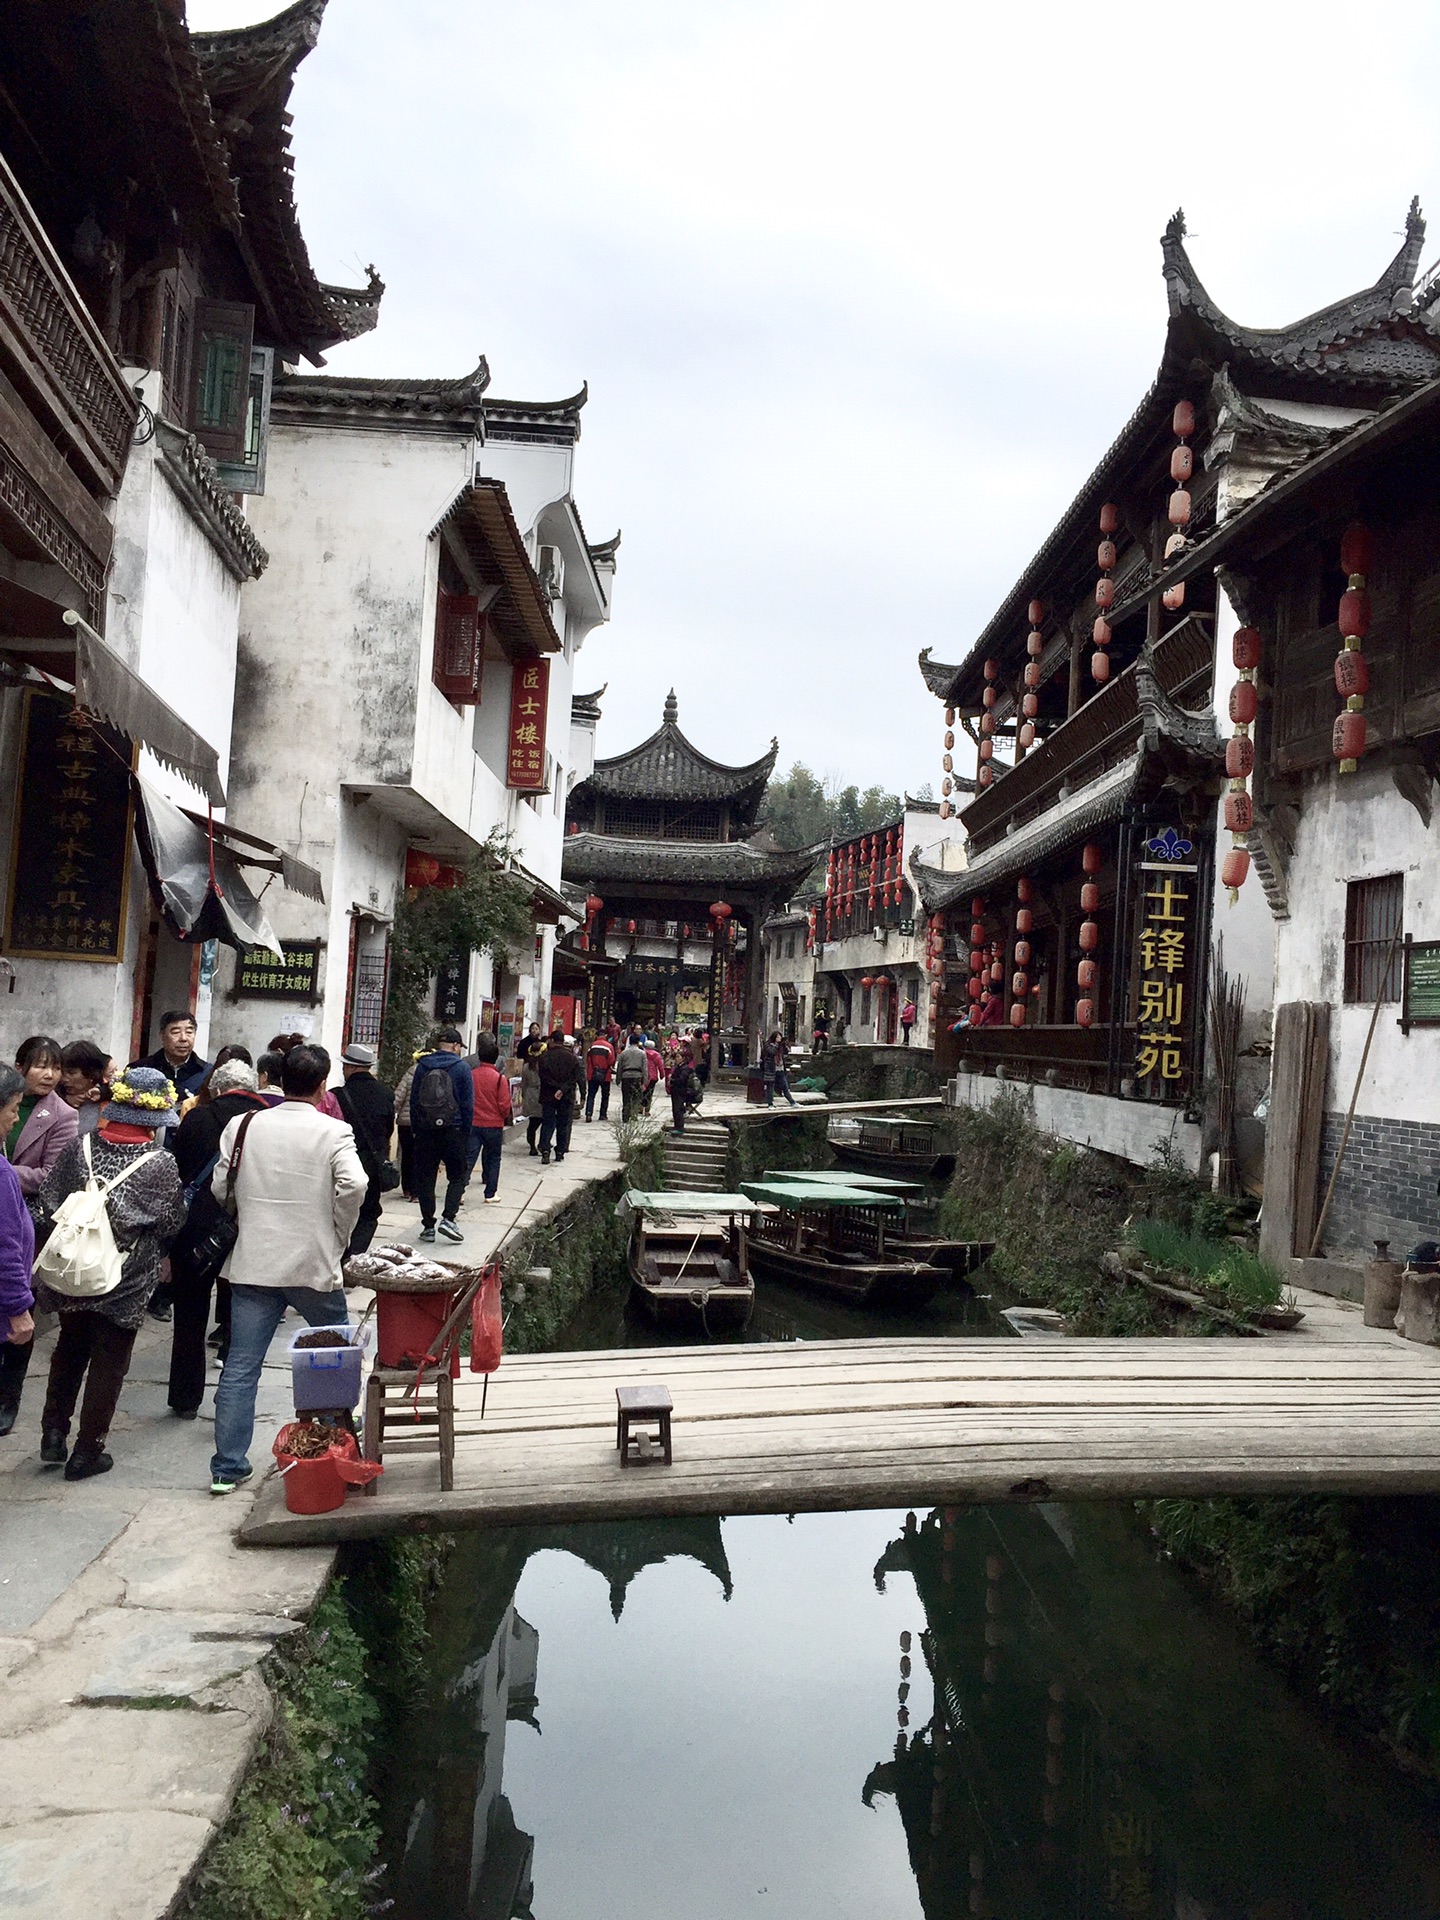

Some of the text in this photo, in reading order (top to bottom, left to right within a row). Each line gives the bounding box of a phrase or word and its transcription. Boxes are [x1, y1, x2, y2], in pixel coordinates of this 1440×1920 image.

[1339, 656, 1356, 688] 银楼
[515, 667, 541, 745] 匠士楼
[511, 759, 540, 769] 住宿
[512, 749, 541, 759] 吃饭
[1239, 741, 1252, 769] 银楼
[1234, 797, 1249, 826] 银楼
[241, 971, 312, 991] 优生优育子女成材
[1137, 879, 1189, 1079] 士锋别苑
